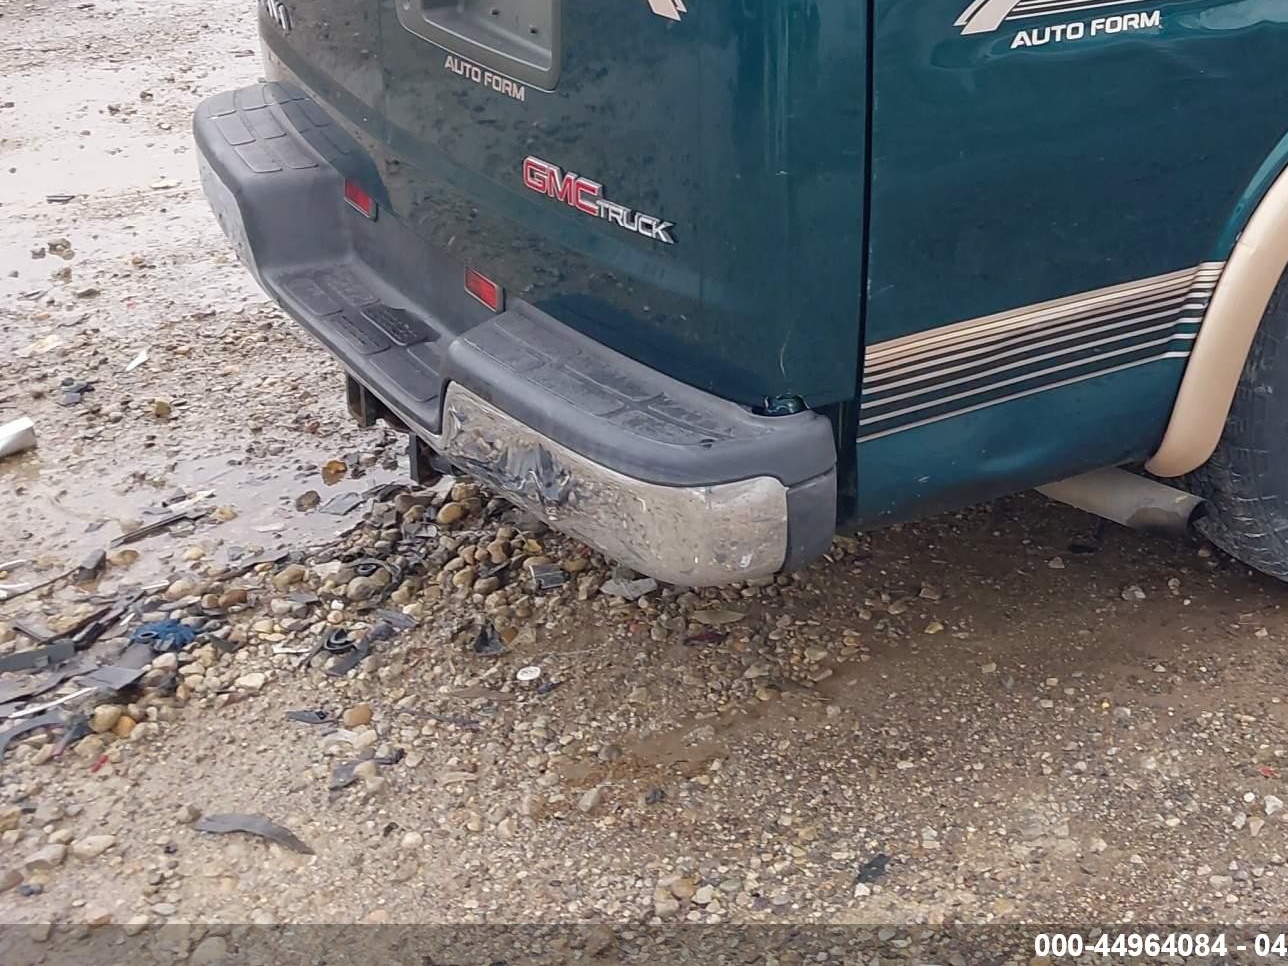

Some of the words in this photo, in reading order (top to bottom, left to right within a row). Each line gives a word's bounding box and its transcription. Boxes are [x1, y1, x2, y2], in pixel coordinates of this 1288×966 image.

[1010, 22, 1084, 49] AUTO
[1090, 10, 1160, 36] FORM
[444, 55, 481, 83] AUTO
[484, 71, 525, 101] FORM
[523, 155, 602, 216] GMC
[596, 198, 675, 244] TRUCK
